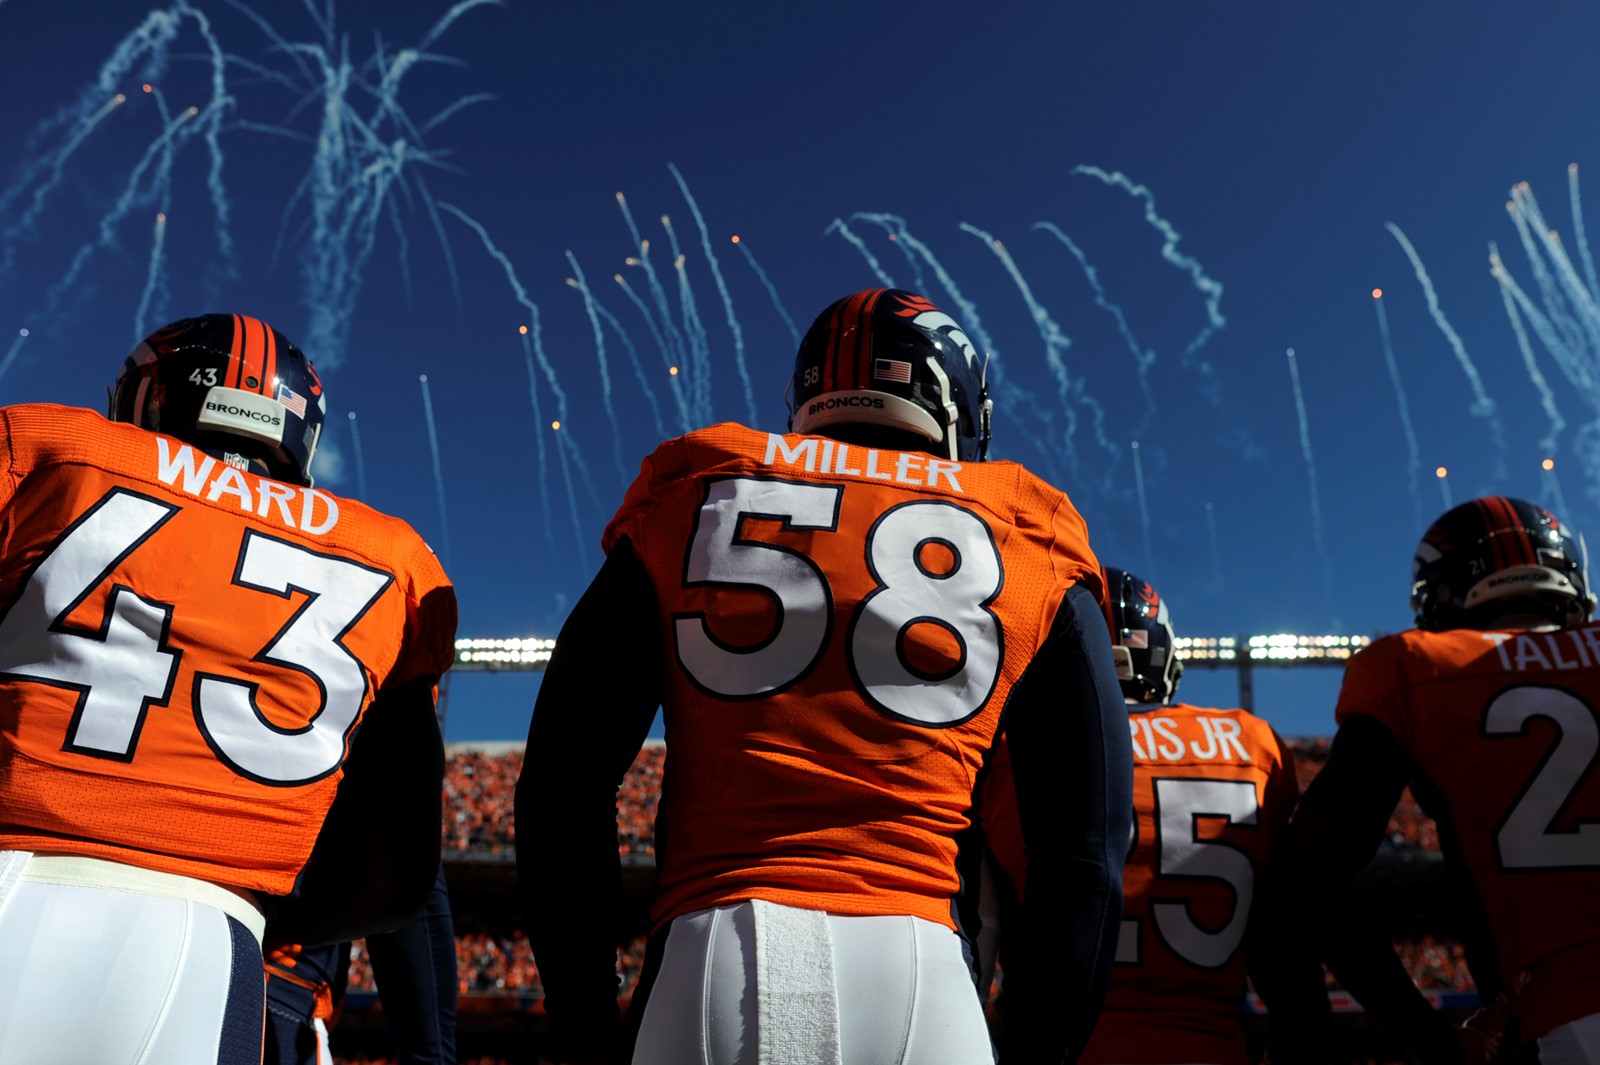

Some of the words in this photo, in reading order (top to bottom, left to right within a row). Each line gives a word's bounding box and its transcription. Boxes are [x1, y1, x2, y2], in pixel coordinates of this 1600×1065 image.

[188, 367, 218, 387] 43
[804, 366, 819, 387] 58
[205, 402, 281, 426] BRONCOS
[808, 396, 885, 416] BRONCOS
[763, 432, 964, 494] MILLER
[155, 436, 339, 536] WARD
[1469, 558, 1486, 576] 21
[672, 475, 1006, 729] 58
[0, 485, 396, 788] 43
[1190, 716, 1253, 761] JR
